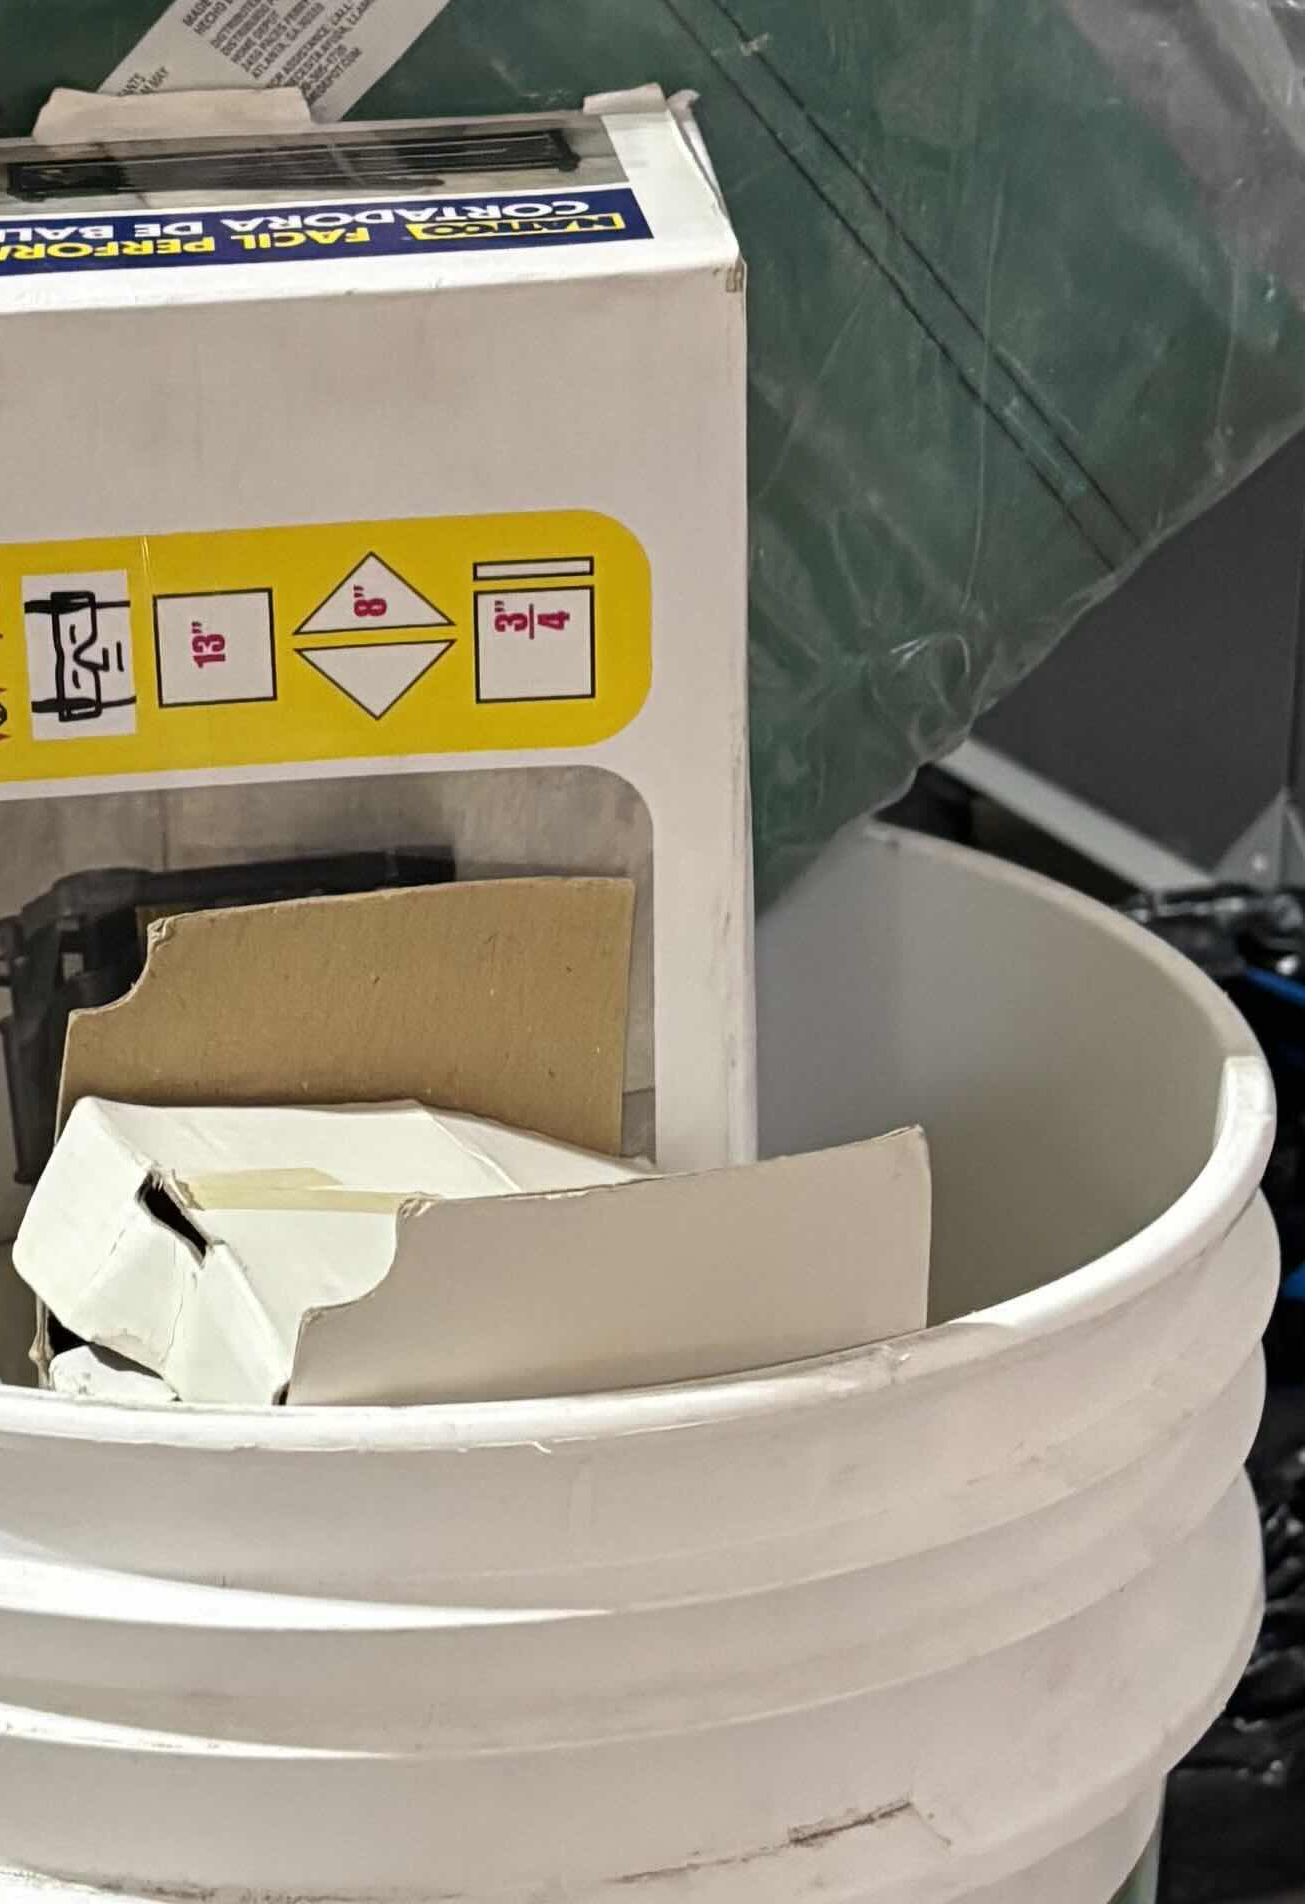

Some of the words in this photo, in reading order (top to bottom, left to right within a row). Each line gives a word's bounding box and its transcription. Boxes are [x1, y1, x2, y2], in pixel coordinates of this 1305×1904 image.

[192, 0, 228, 37] HECHO
[134, 221, 203, 238] DE
[221, 200, 590, 232] CORTADORA
[231, 227, 371, 250] FACIL
[353, 585, 388, 618] 8"
[192, 621, 226, 668] 13"
